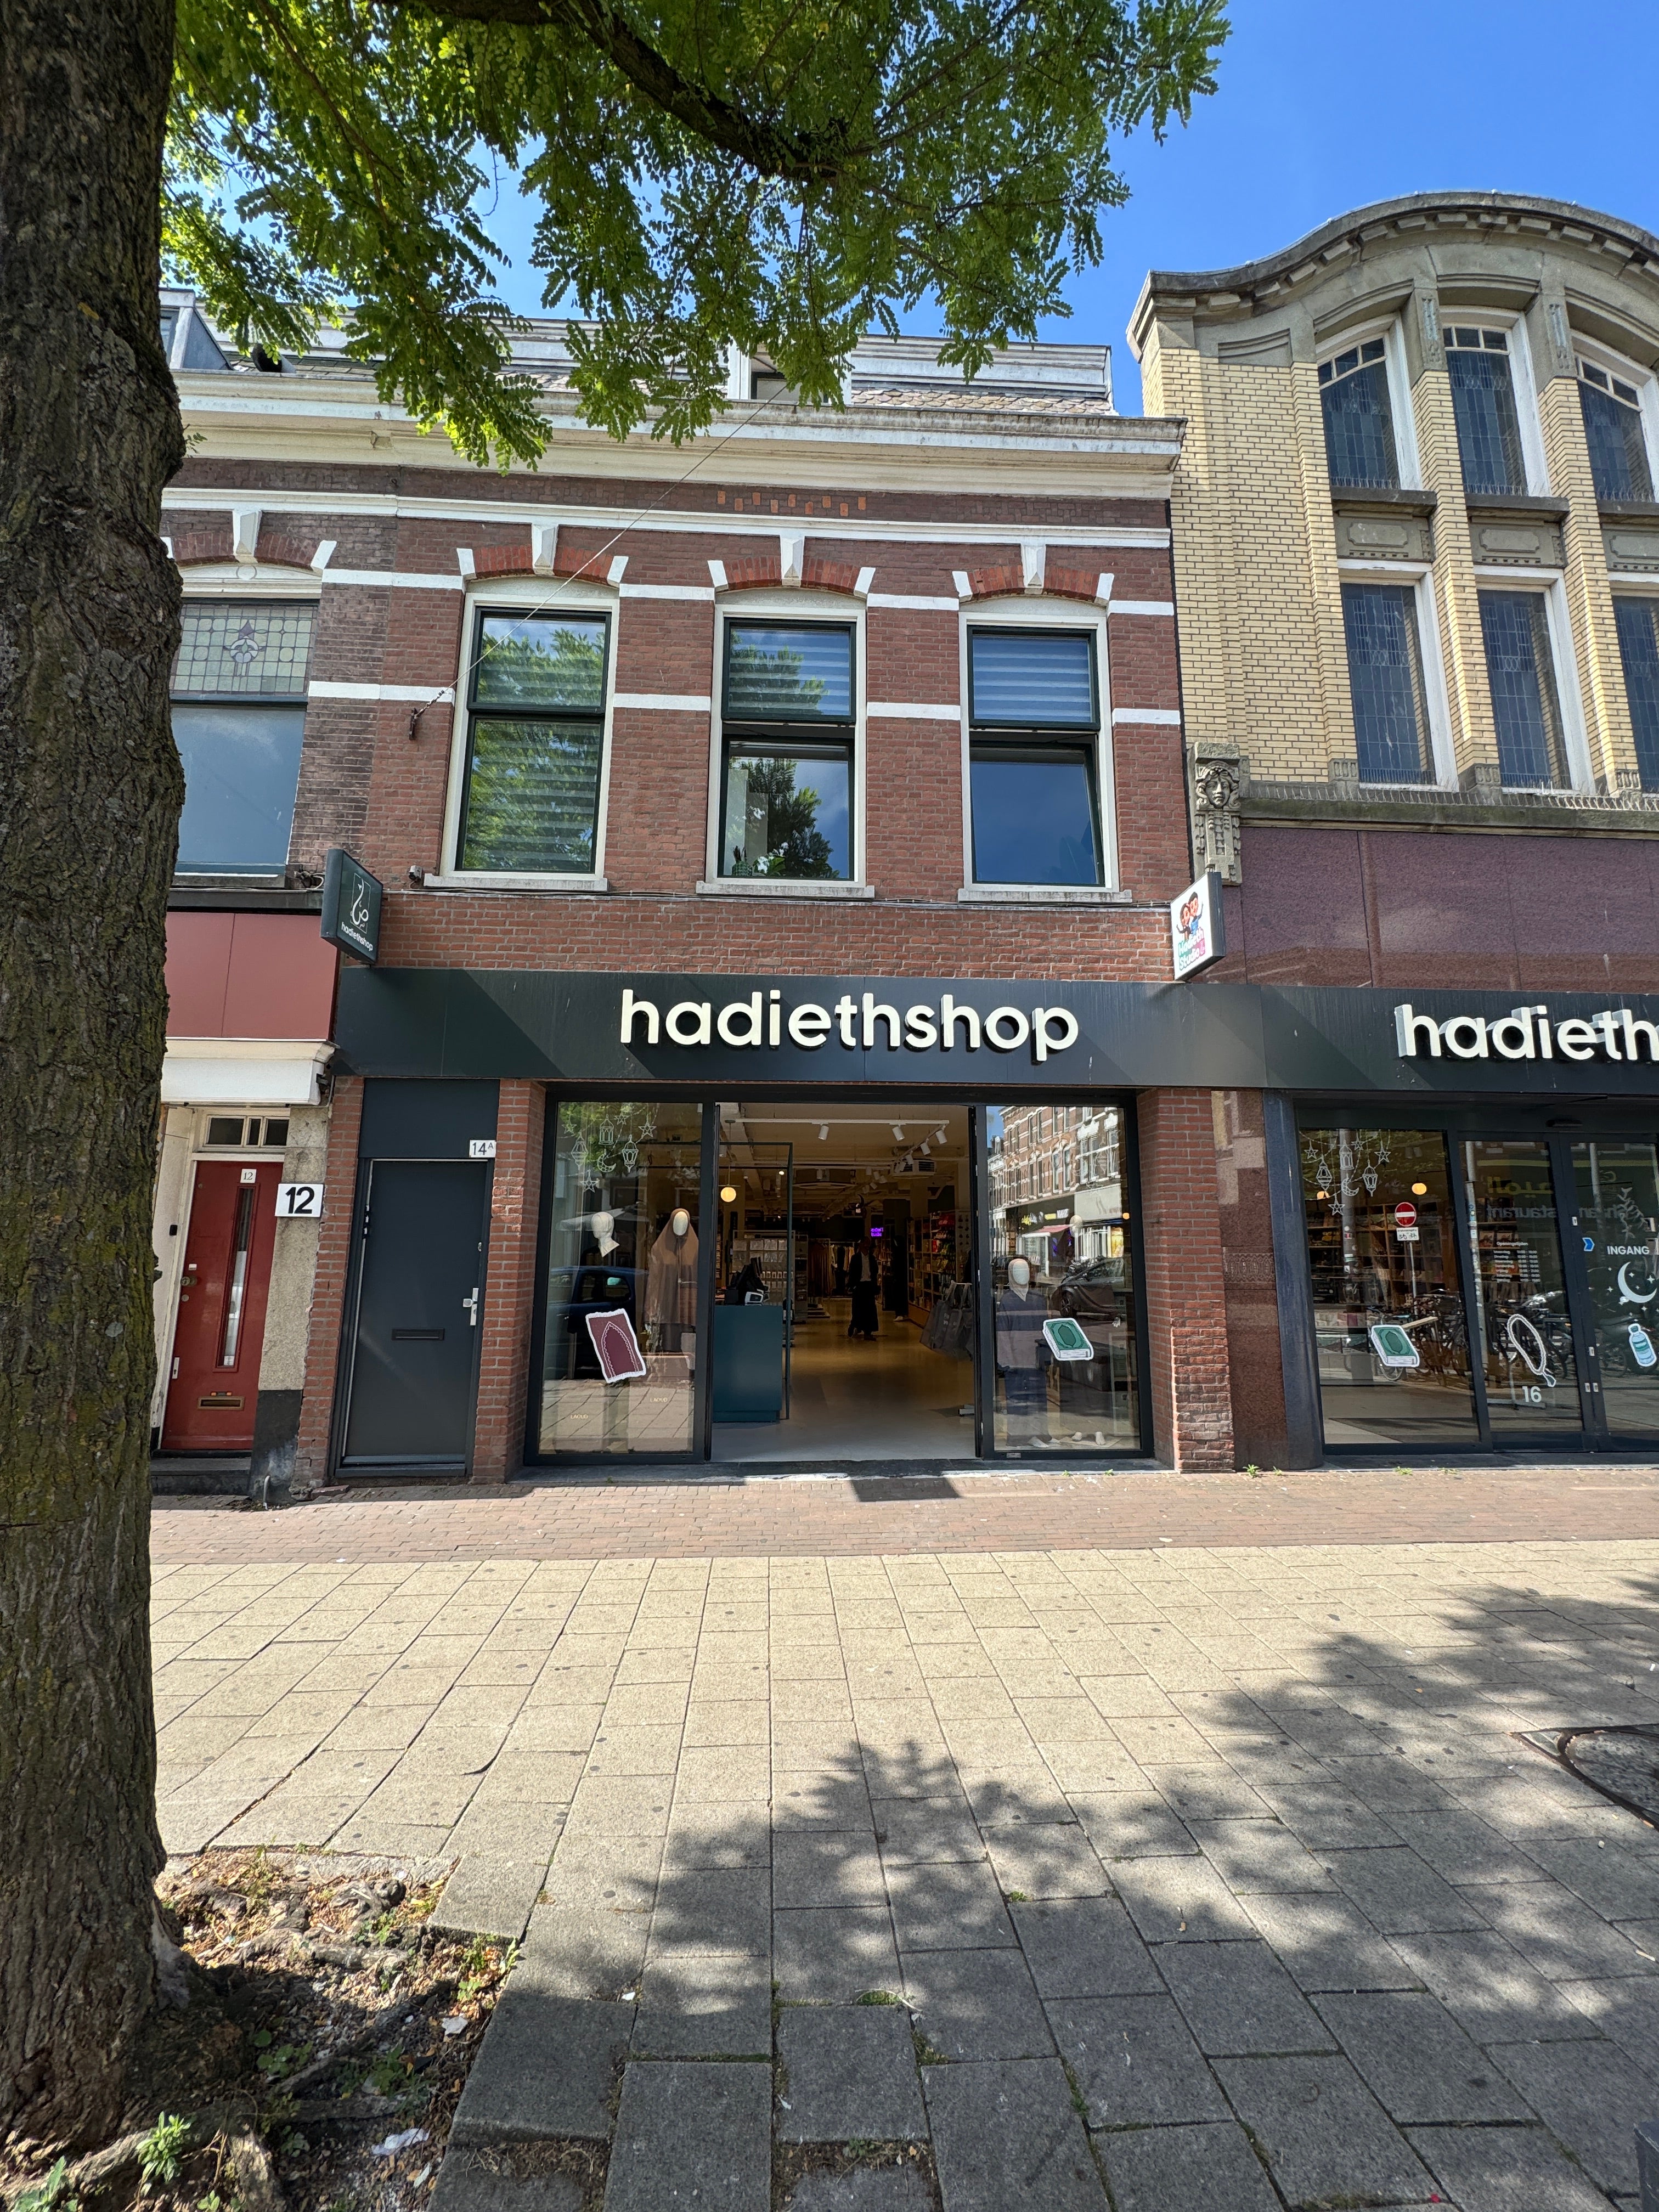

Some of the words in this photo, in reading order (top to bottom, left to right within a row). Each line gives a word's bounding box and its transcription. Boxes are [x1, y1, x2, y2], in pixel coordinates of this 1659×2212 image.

[341, 922, 373, 951] hadiethshop
[1178, 927, 1204, 957] Hadieth
[620, 989, 1079, 1062] hadiethshop
[1395, 1004, 1659, 1061] hadieth
[244, 1172, 253, 1180] 12
[285, 1186, 315, 1214] 12
[1607, 1246, 1650, 1255] INGANG
[1522, 1386, 1542, 1403] 16
